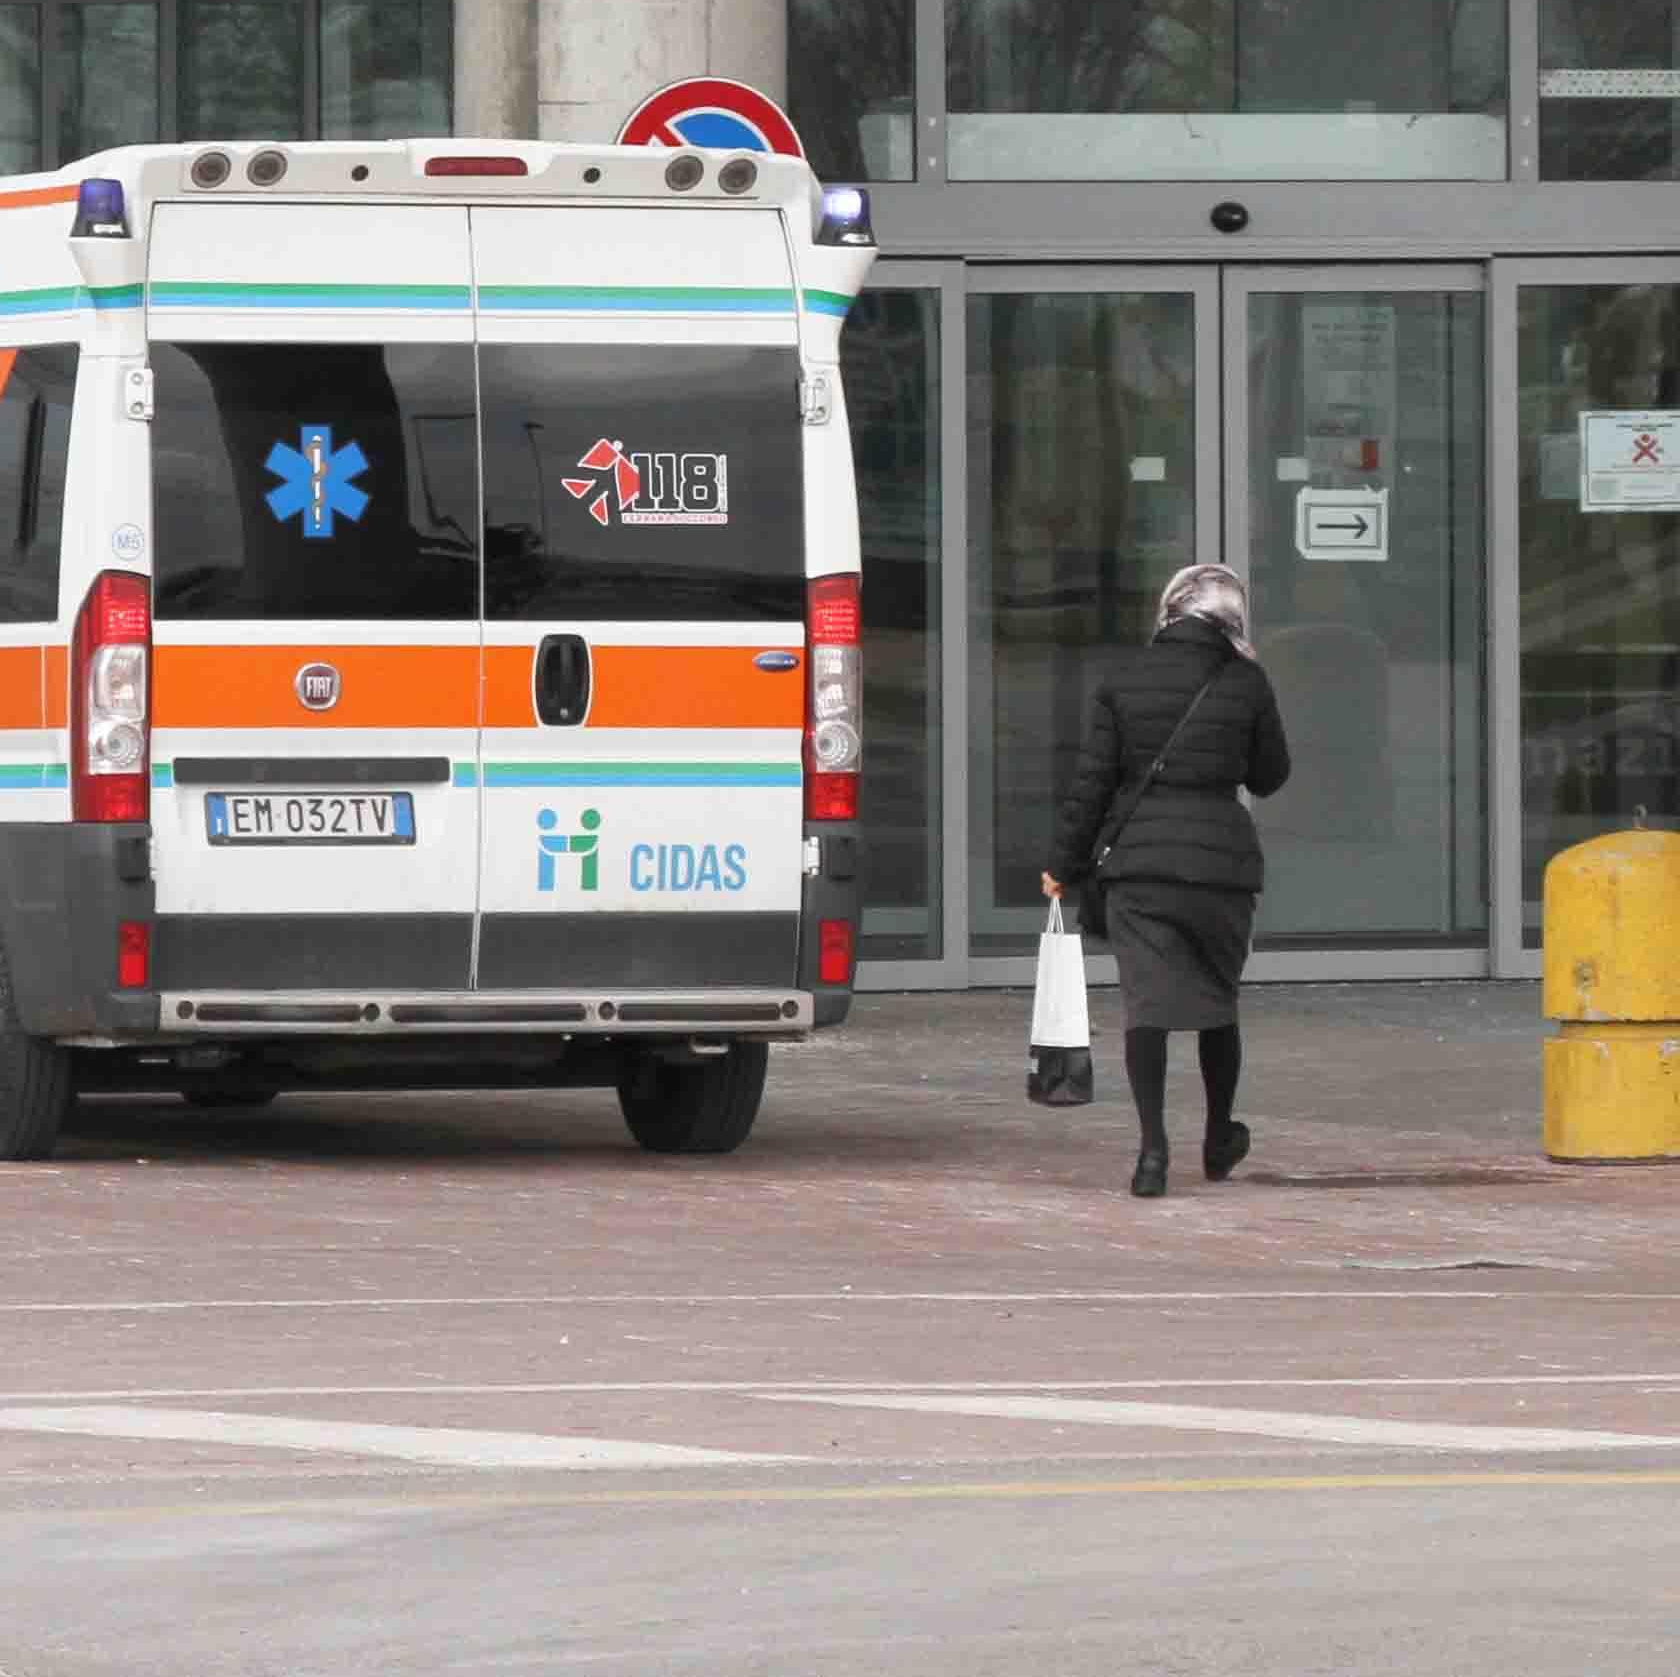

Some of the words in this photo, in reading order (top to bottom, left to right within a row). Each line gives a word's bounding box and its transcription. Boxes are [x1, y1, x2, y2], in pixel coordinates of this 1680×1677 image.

[630, 452, 720, 512] 118
[306, 675, 332, 698] FIAT
[232, 798, 273, 833] EM
[286, 798, 388, 833] 032TV
[629, 842, 747, 892] CIDAS
